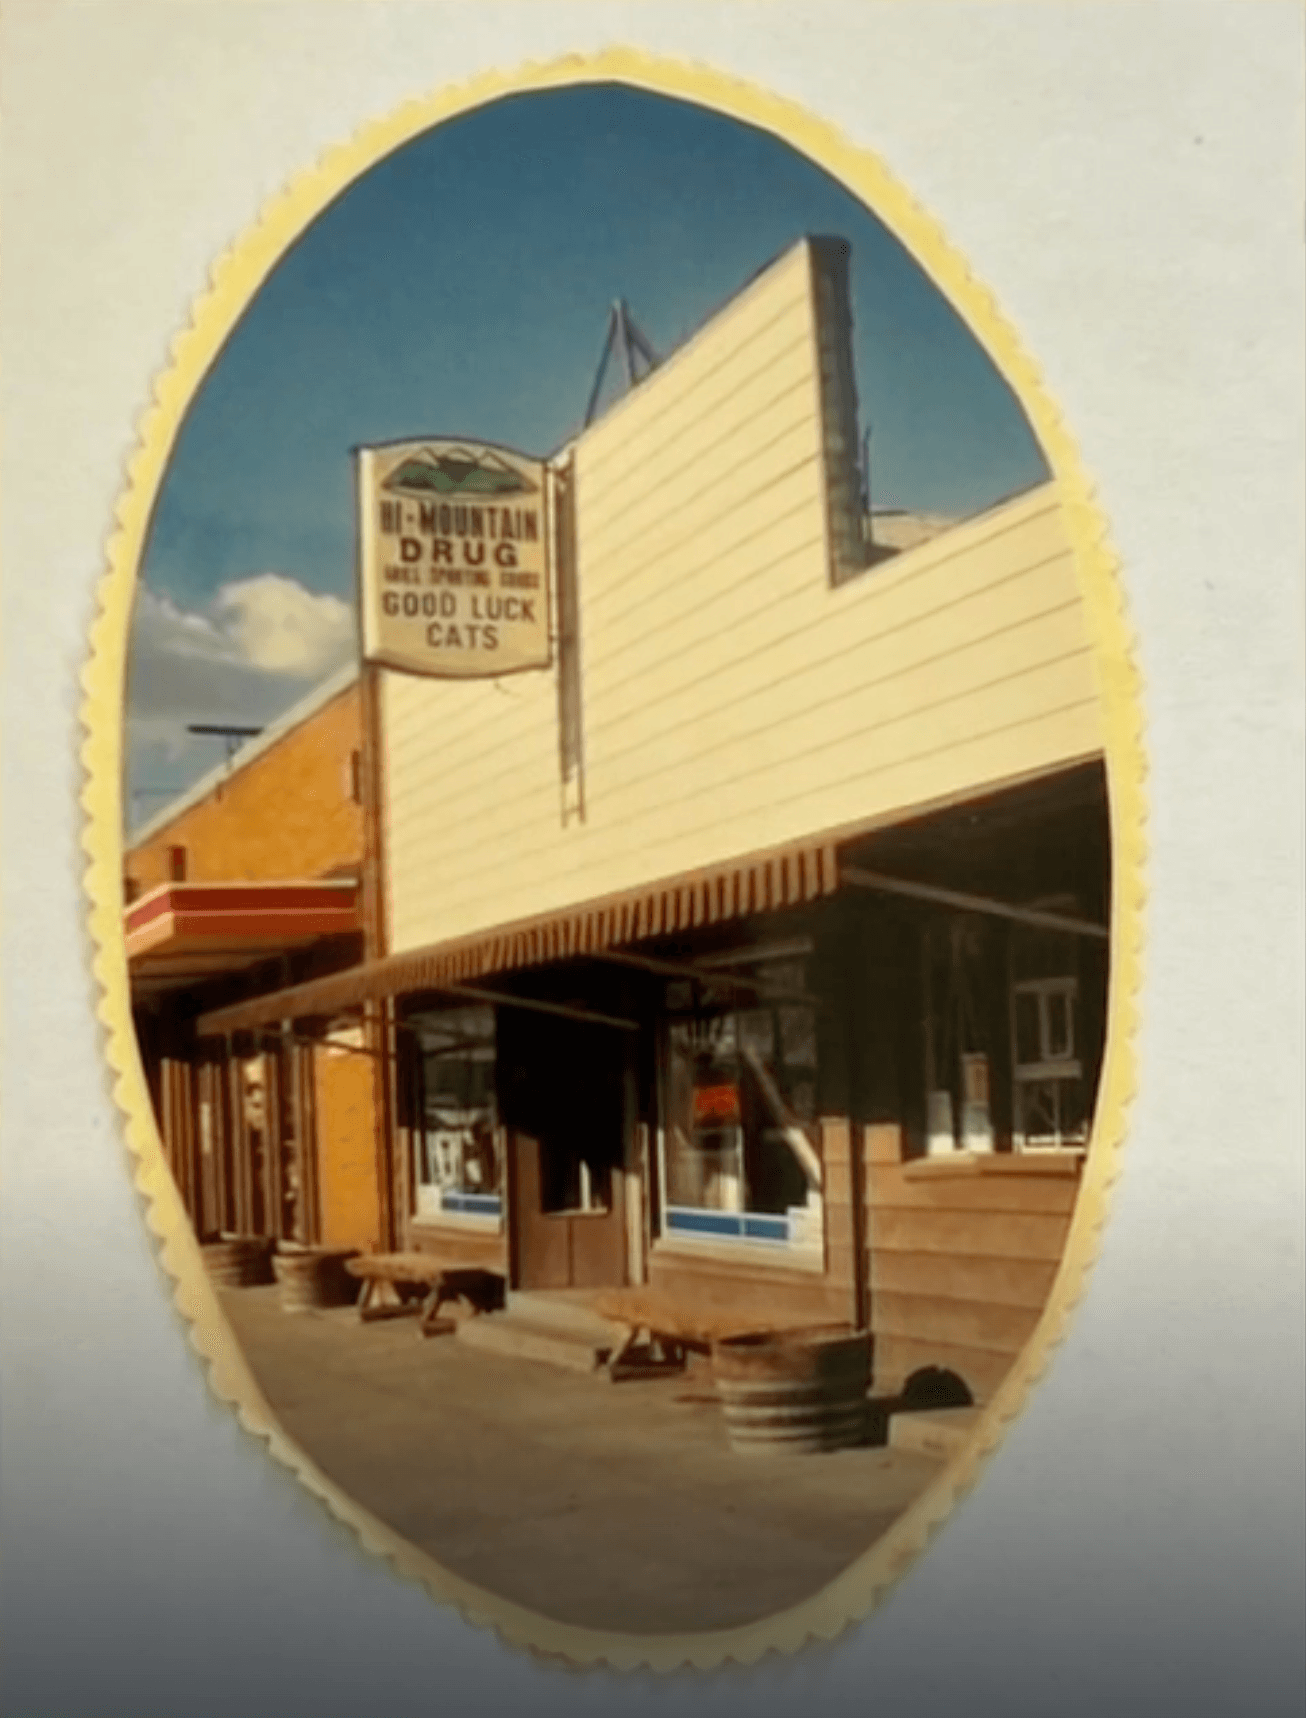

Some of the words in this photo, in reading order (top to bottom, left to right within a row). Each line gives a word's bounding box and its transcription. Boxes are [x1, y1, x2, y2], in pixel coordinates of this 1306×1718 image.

[379, 501, 538, 541] HI-MOUNTAIN
[400, 537, 518, 567] DRUG
[382, 591, 457, 617] GOOD
[470, 596, 536, 623] LUCK
[425, 622, 499, 650] CATS
